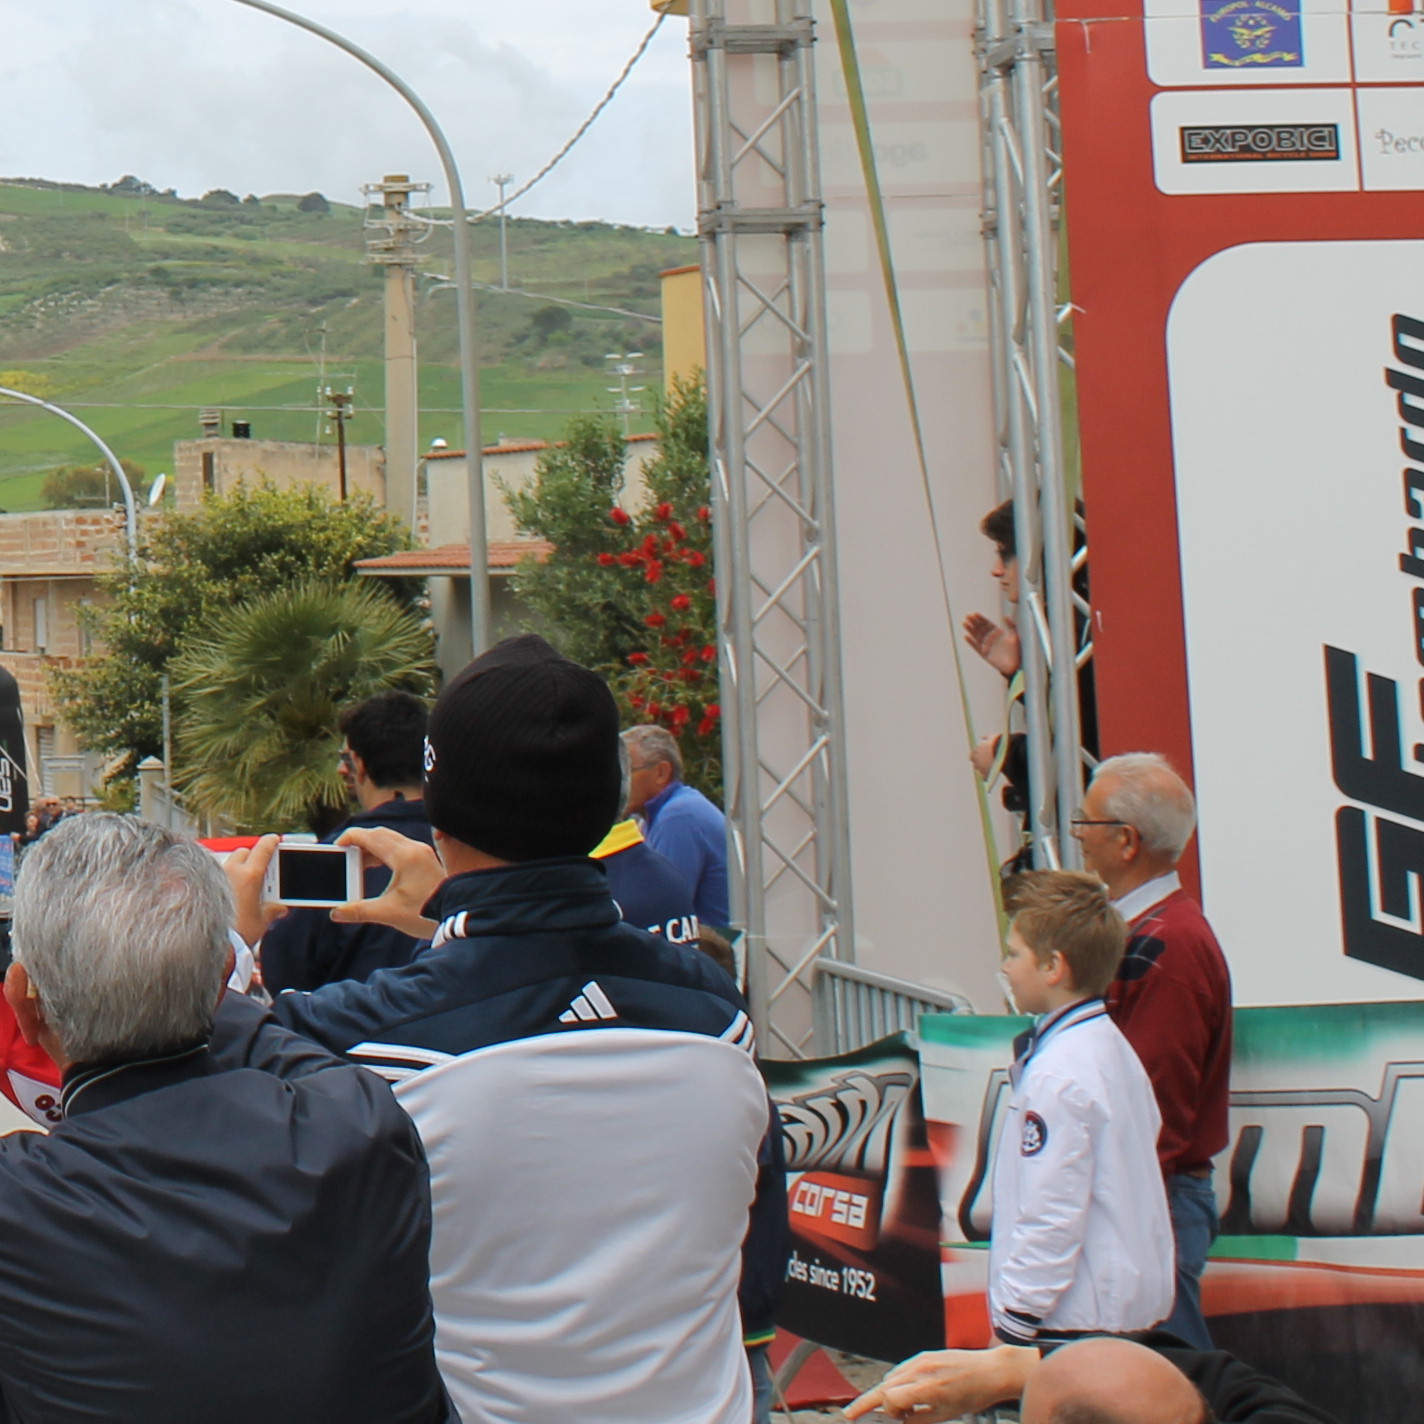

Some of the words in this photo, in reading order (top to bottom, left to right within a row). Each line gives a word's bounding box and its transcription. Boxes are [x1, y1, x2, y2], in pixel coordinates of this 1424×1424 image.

[1184, 127, 1336, 153] EXPOBICI
[792, 1180, 870, 1229] corsa
[809, 1255, 840, 1293] since
[841, 1265, 877, 1303] 1952
